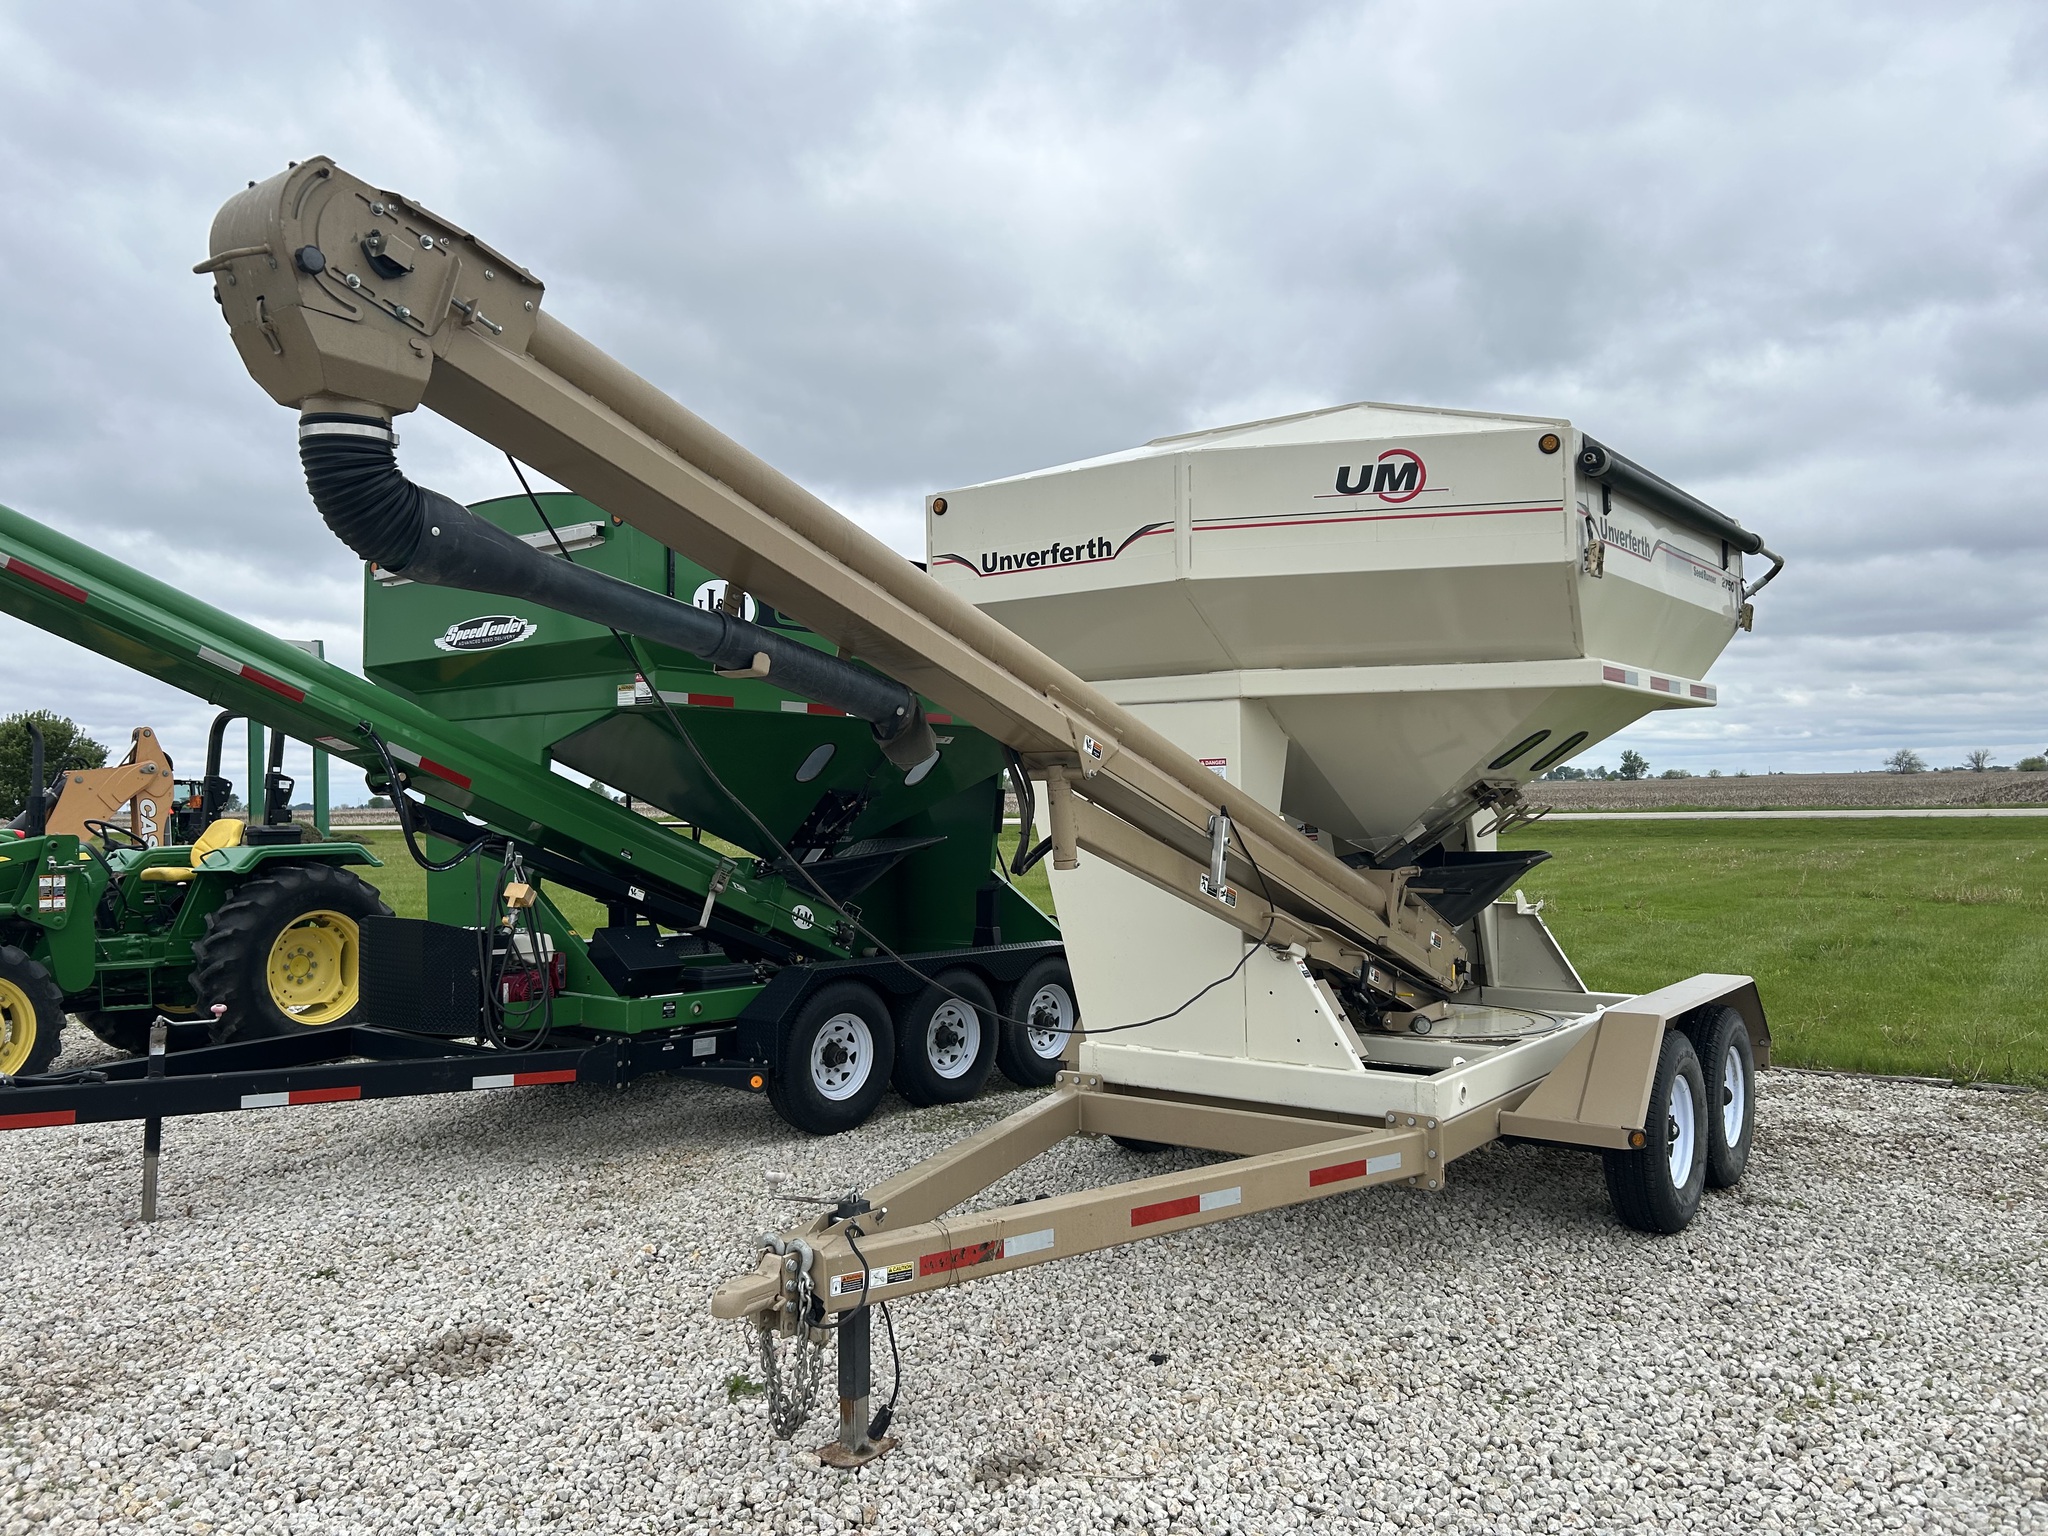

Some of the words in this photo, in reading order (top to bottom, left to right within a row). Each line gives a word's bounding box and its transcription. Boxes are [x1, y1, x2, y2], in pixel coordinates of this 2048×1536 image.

[1335, 462, 1419, 495] UM
[1600, 516, 1651, 559] Unverferth
[981, 536, 1113, 573] Unverferth
[1721, 577, 1735, 593] 2750
[445, 617, 527, 646] SpeedTender
[892, 1264, 913, 1272] CAUTION
